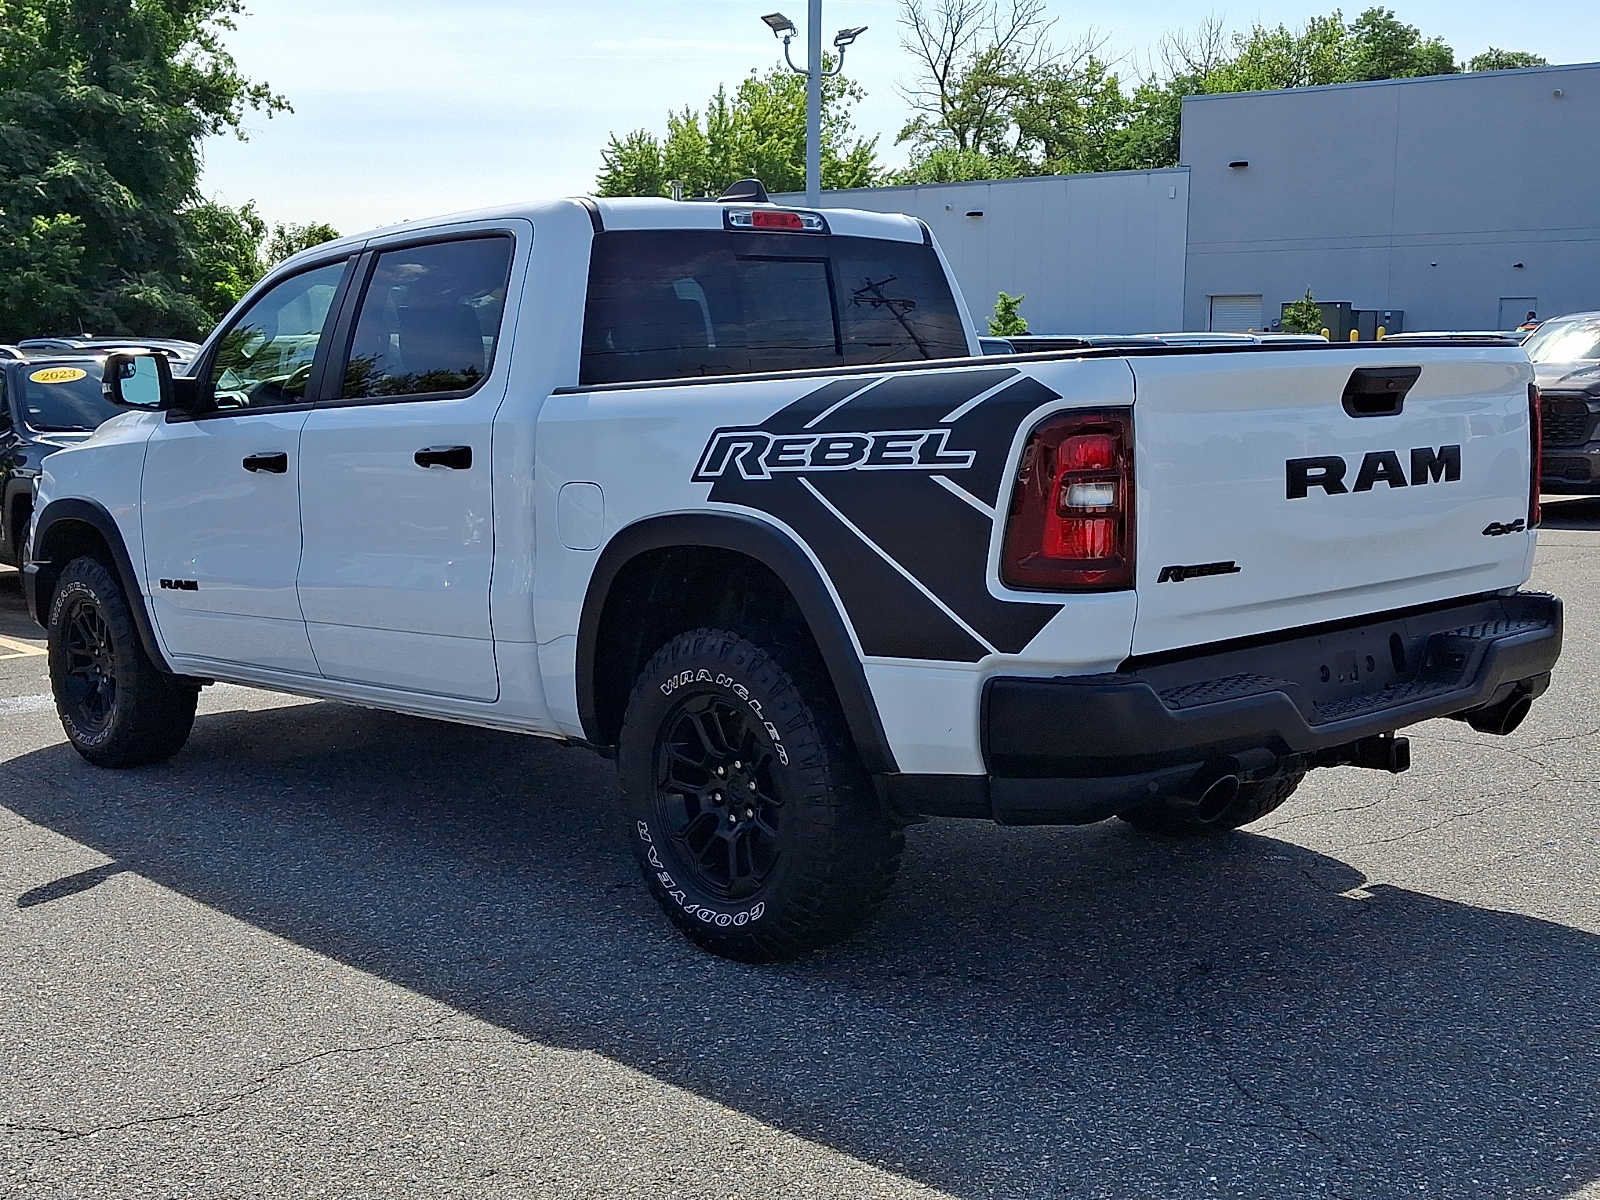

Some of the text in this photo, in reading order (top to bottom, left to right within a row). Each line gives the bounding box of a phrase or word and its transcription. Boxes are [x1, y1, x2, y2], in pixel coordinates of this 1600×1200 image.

[40, 370, 76, 381] 2023
[697, 428, 977, 480] REBEL
[1286, 444, 1461, 500] RAM
[160, 578, 198, 591] RAM
[659, 668, 790, 769] WRANGLER
[636, 819, 766, 928] GOODYEAR
